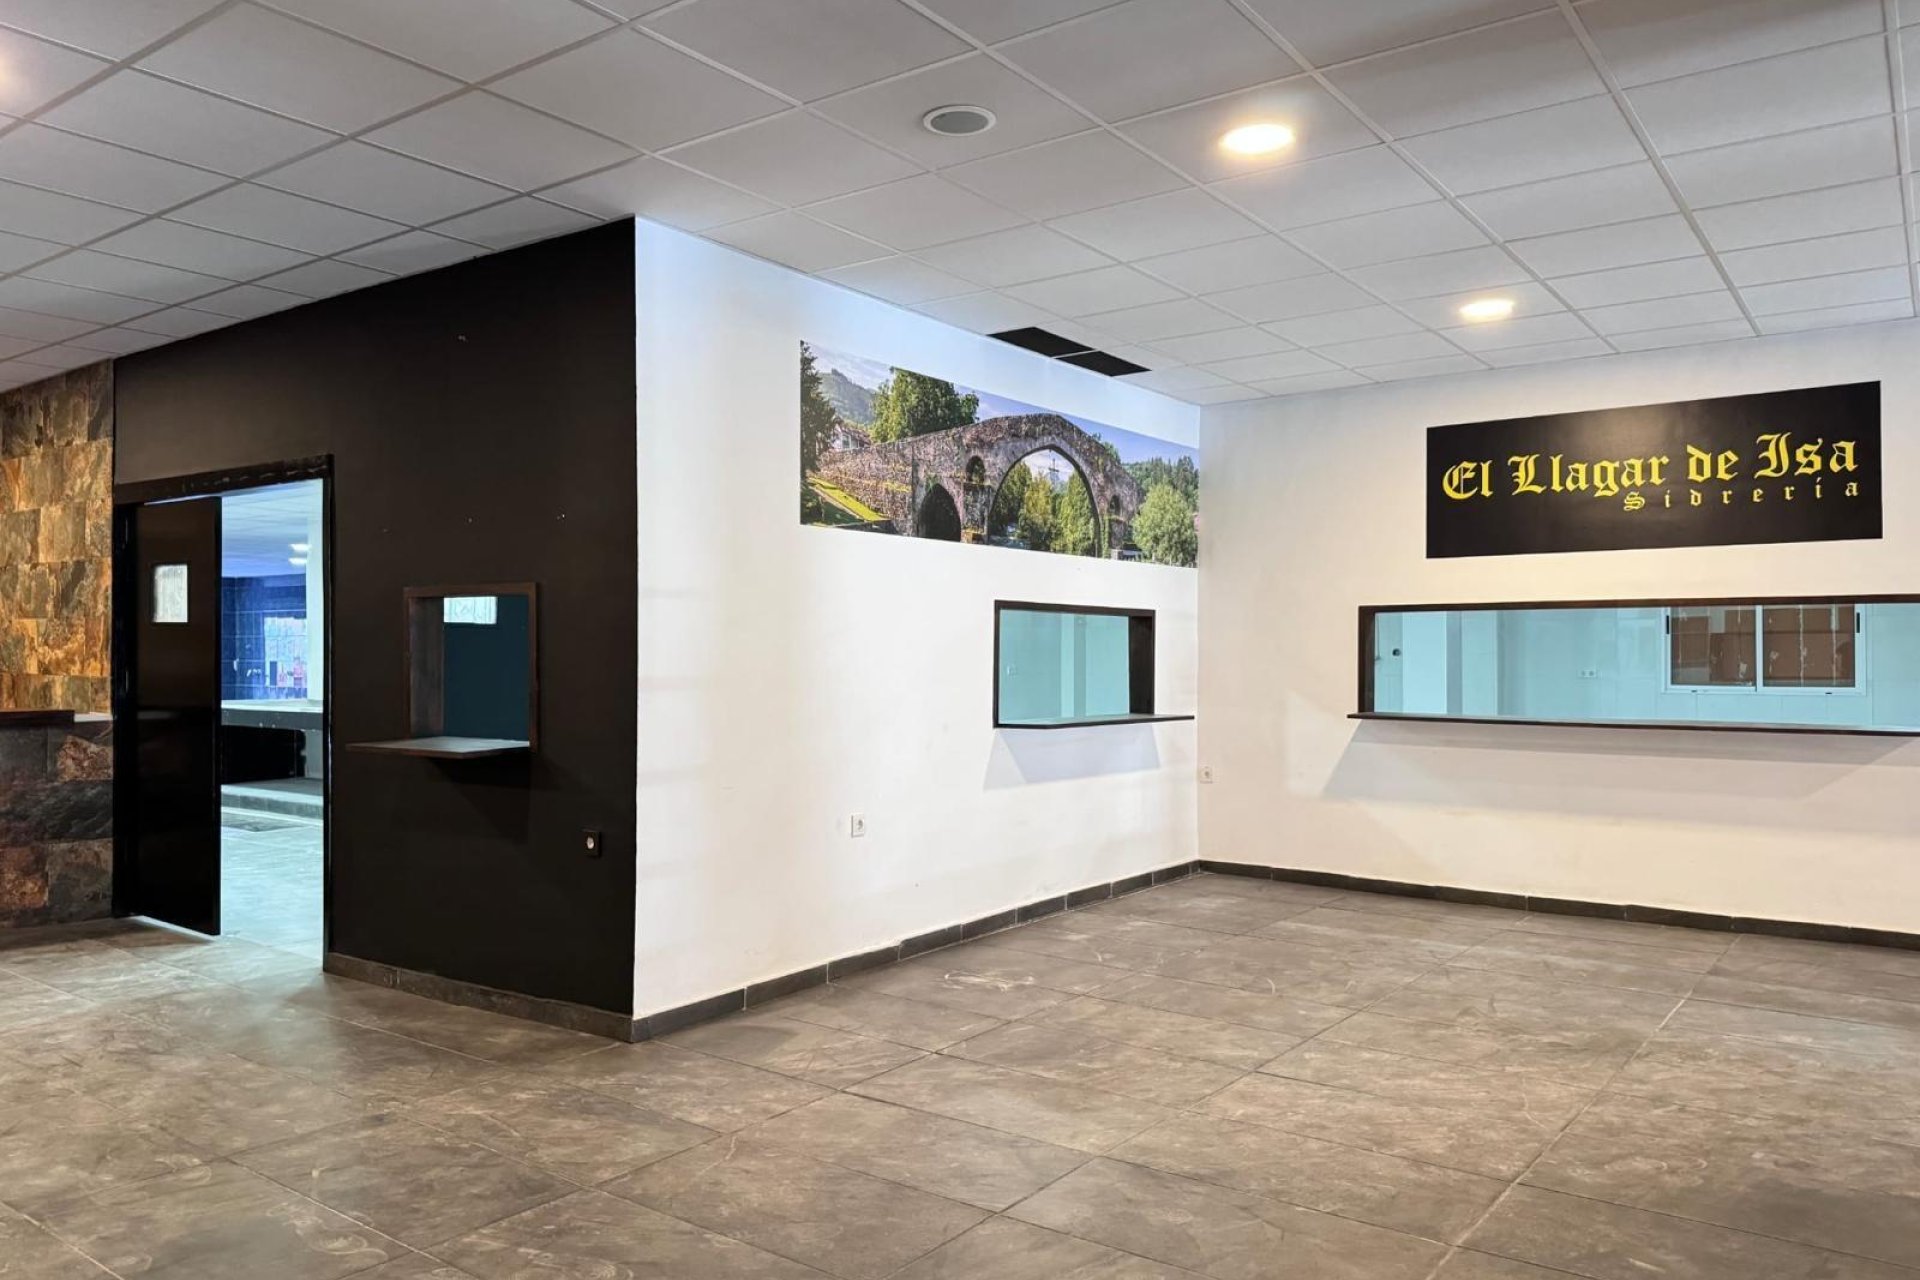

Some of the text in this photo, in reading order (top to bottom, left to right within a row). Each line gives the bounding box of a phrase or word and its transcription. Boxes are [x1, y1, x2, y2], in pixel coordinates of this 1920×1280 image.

[1442, 432, 1859, 500] El Llagar de Isa
